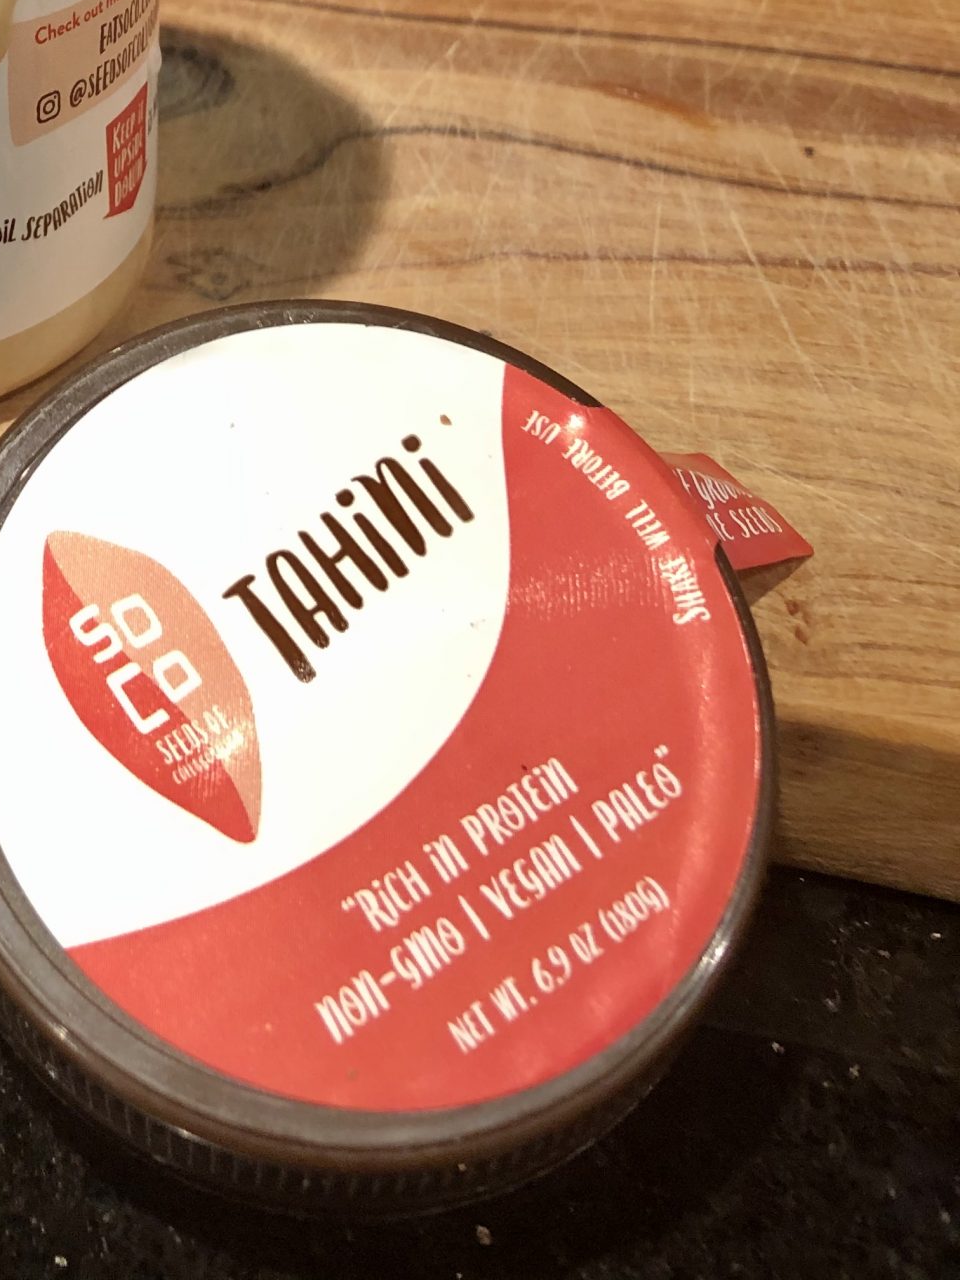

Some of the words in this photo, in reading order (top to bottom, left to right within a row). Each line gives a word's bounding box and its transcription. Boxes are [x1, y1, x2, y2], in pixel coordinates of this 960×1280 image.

[35, 12, 81, 45] Check
[84, 0, 103, 22] out
[113, 112, 135, 154] KEEP
[521, 410, 562, 445] USE
[561, 437, 631, 501] BEFORE
[624, 499, 671, 551] WELL
[729, 506, 783, 538] SEEDS
[658, 555, 711, 625] SHAKE
[69, 593, 163, 663] SO
[106, 649, 202, 735] CO
[156, 720, 209, 764] SEEDS
[447, 1001, 494, 1054] NET
[490, 977, 539, 1021] WT.
[569, 922, 605, 964] OZ
